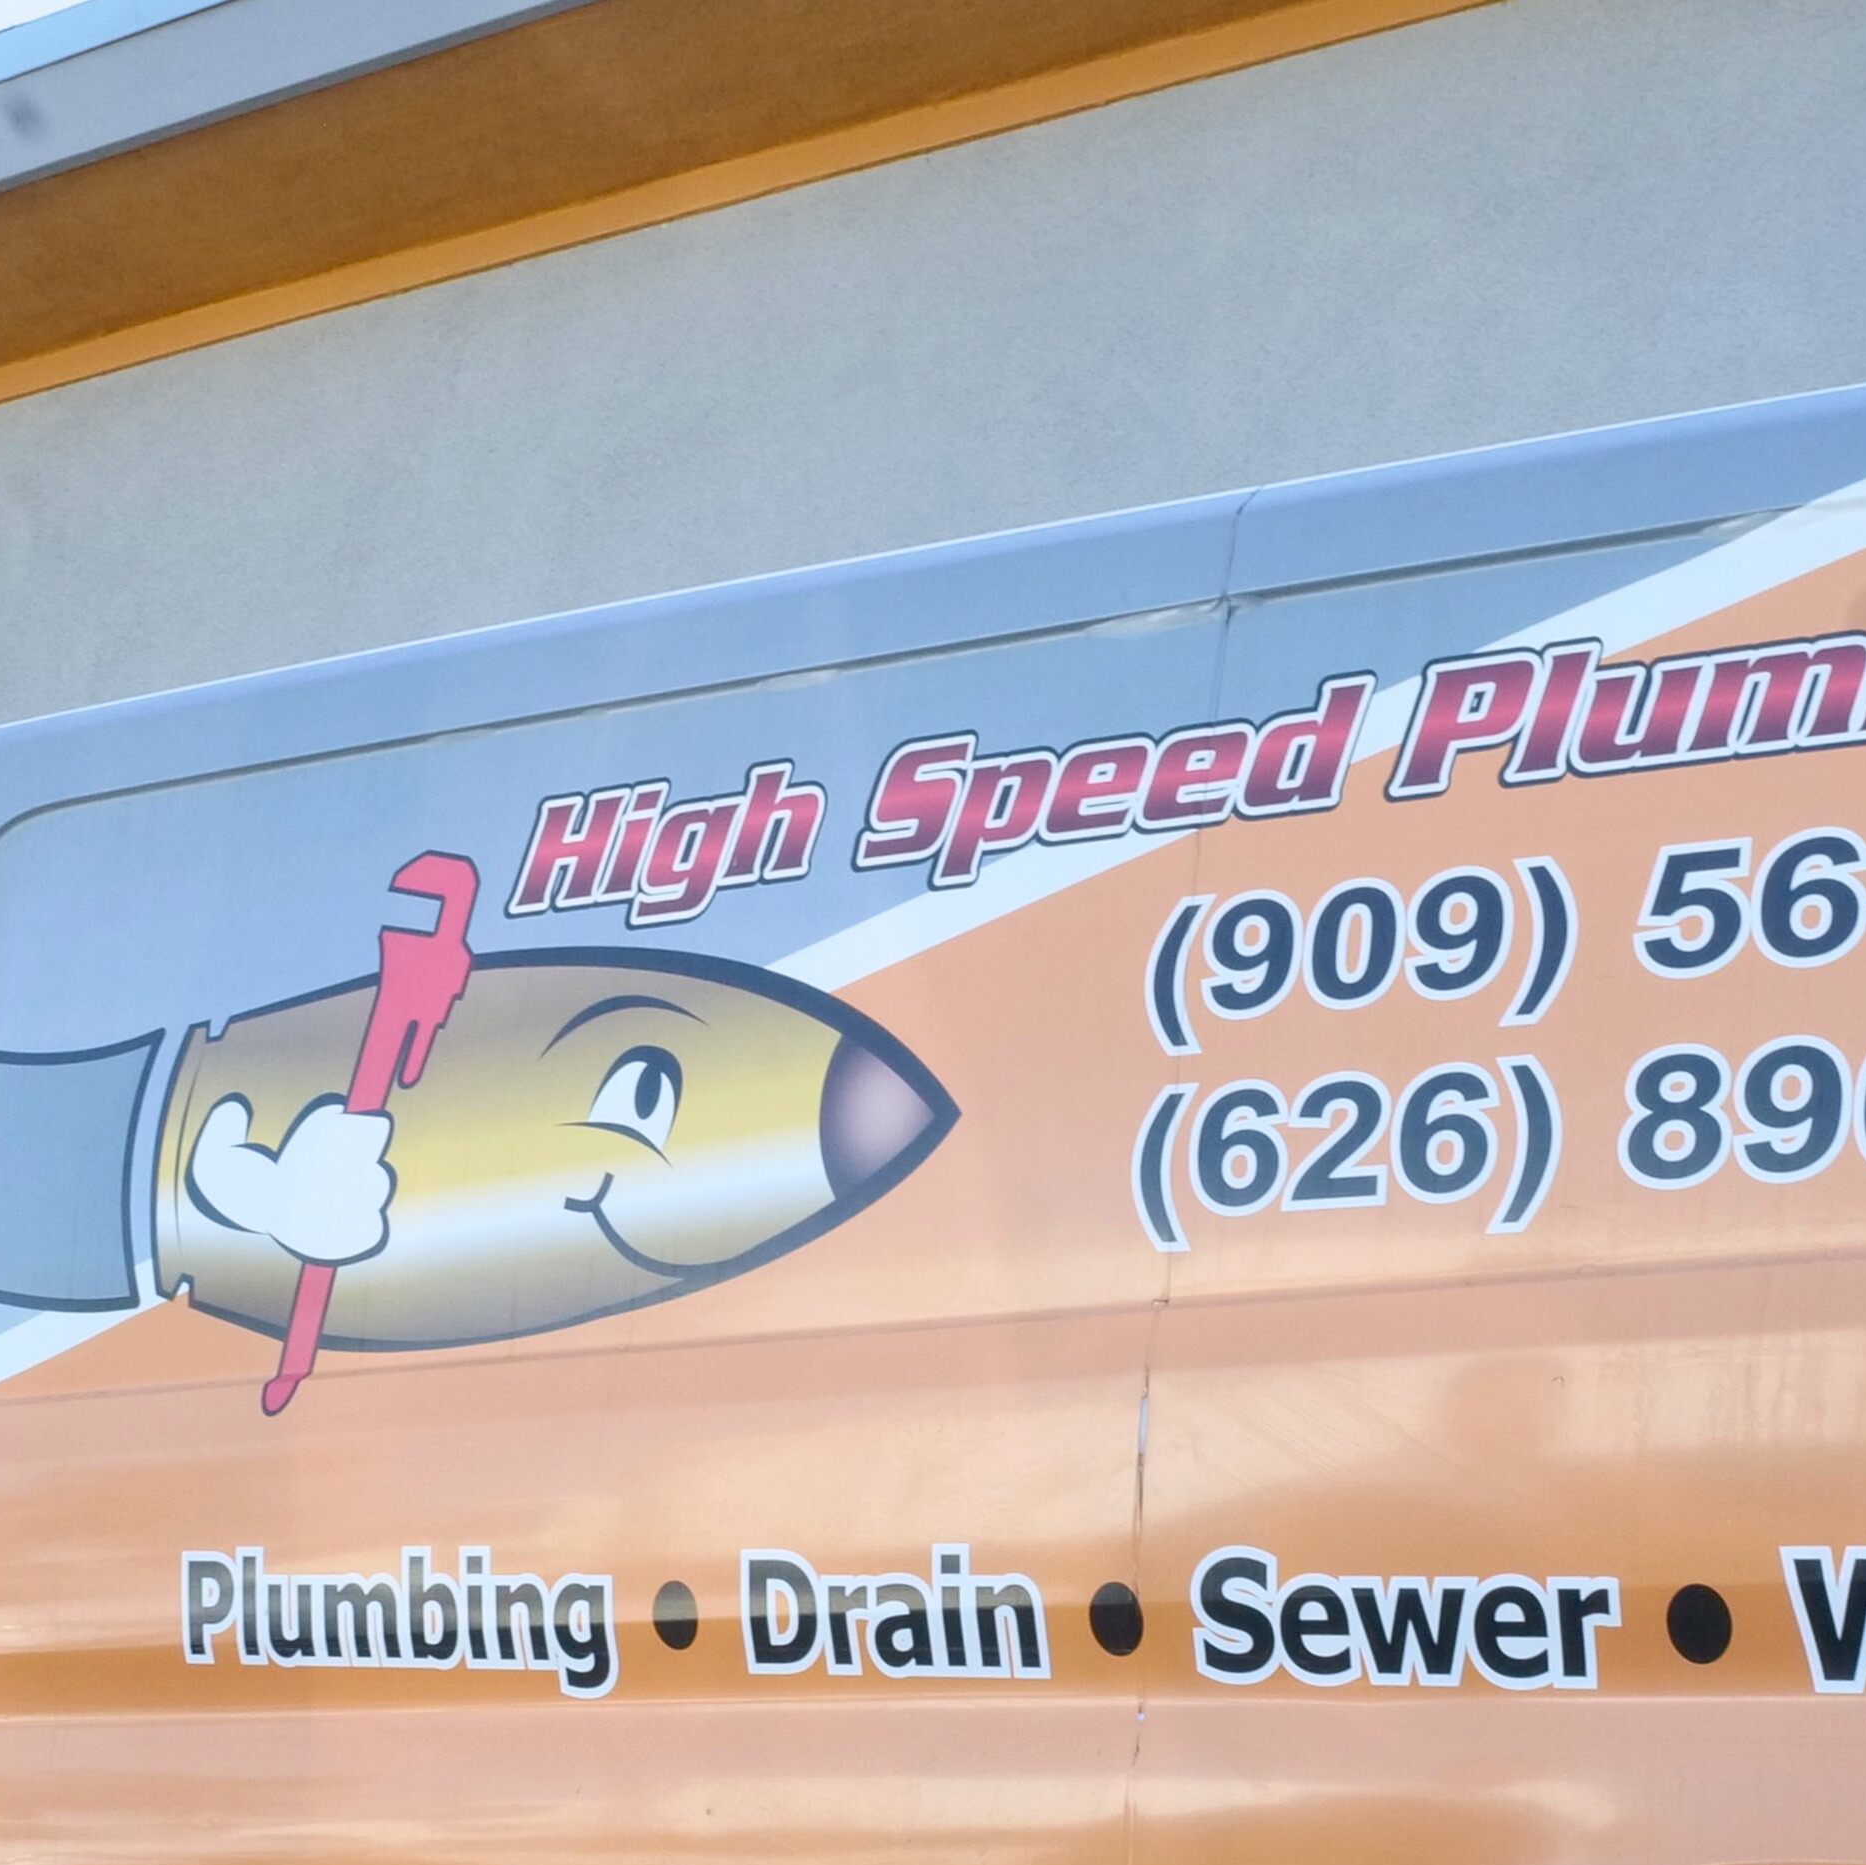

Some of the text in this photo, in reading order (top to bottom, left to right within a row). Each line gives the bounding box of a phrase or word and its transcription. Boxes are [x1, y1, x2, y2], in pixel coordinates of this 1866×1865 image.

[507, 758, 827, 928] High
[852, 671, 1377, 892] Speed
[1144, 857, 1580, 1056] (909)
[1131, 1056, 1564, 1252] (626)
[181, 1546, 617, 1698] Plumbing
[740, 1544, 1051, 1679] Drain
[1193, 1545, 1621, 1690] Sewer
